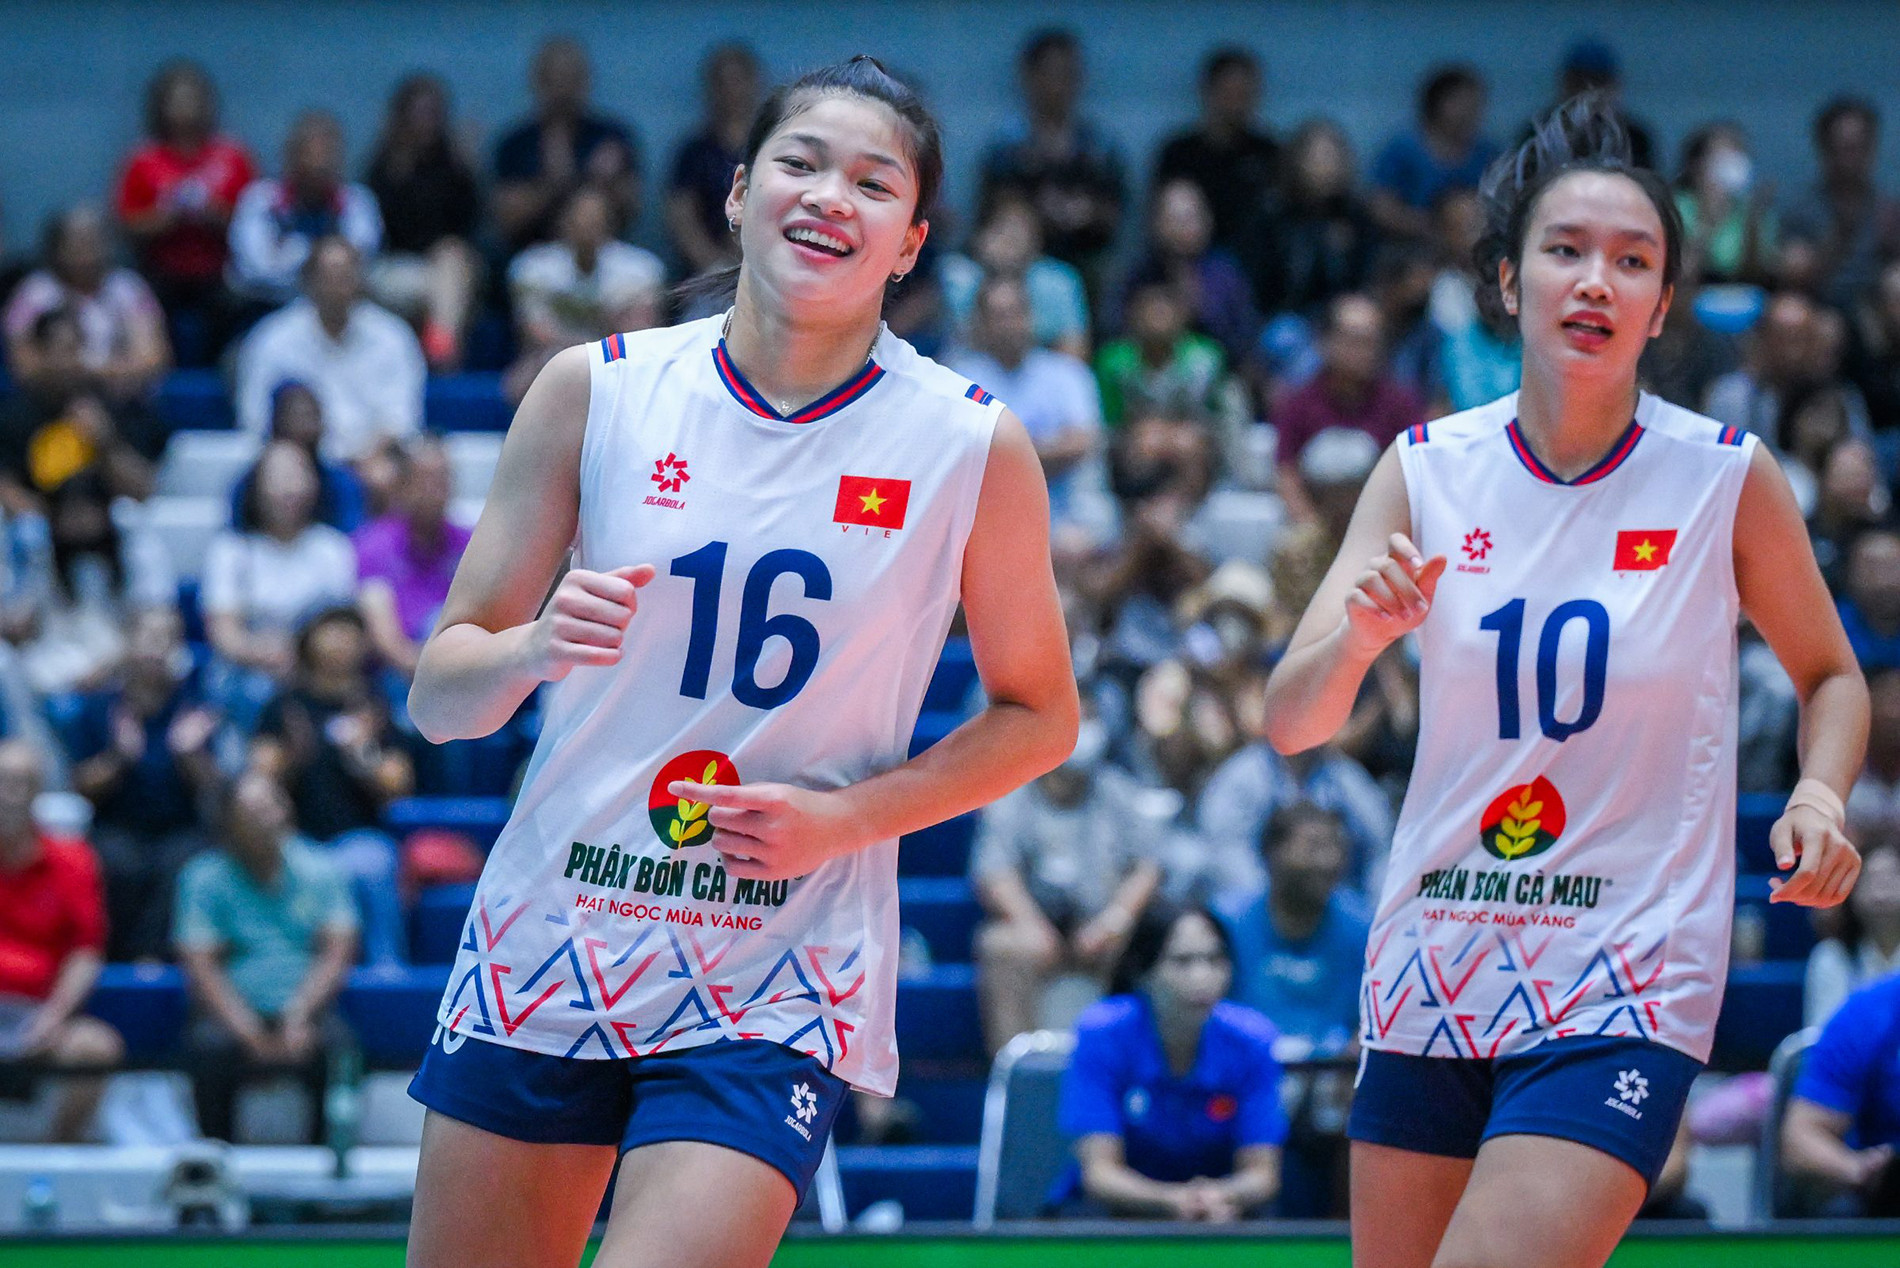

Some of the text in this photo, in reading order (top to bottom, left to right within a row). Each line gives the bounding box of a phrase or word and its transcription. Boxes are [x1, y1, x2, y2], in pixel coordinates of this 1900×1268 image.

[841, 524, 892, 539] VIE
[670, 540, 833, 711] 16
[1479, 598, 1610, 742] 10
[633, 855, 688, 897] BÓN
[691, 857, 727, 903] CÀ
[1515, 868, 1544, 905] CÀ
[608, 899, 662, 922] NGỌC
[665, 905, 703, 927] MÙA
[710, 911, 763, 931] VÀNG
